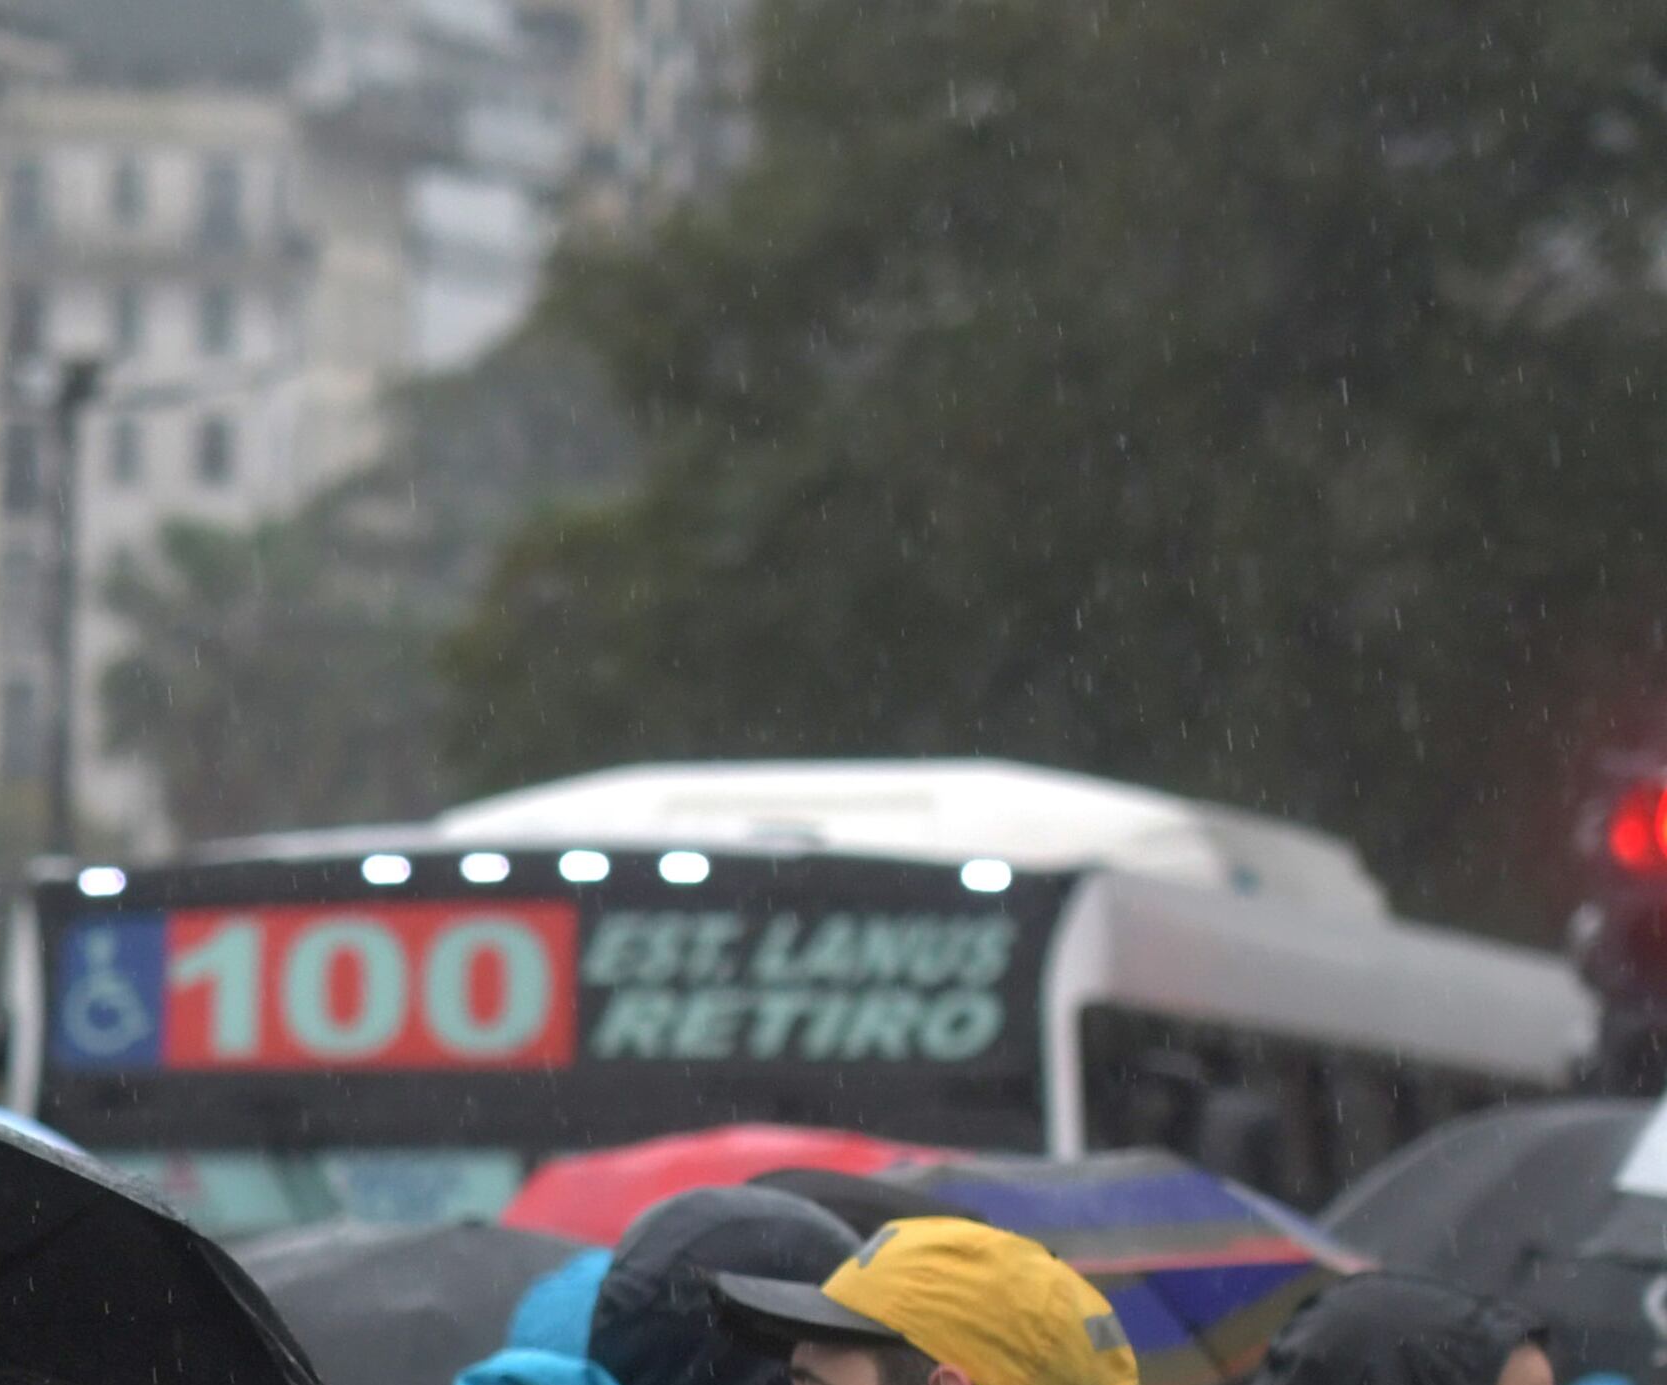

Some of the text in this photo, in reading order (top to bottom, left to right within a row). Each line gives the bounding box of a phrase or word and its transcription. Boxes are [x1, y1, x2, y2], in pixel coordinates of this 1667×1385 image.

[752, 910, 1017, 985] LANUS
[171, 916, 553, 1060] 100
[594, 990, 1005, 1060] RETIRO
